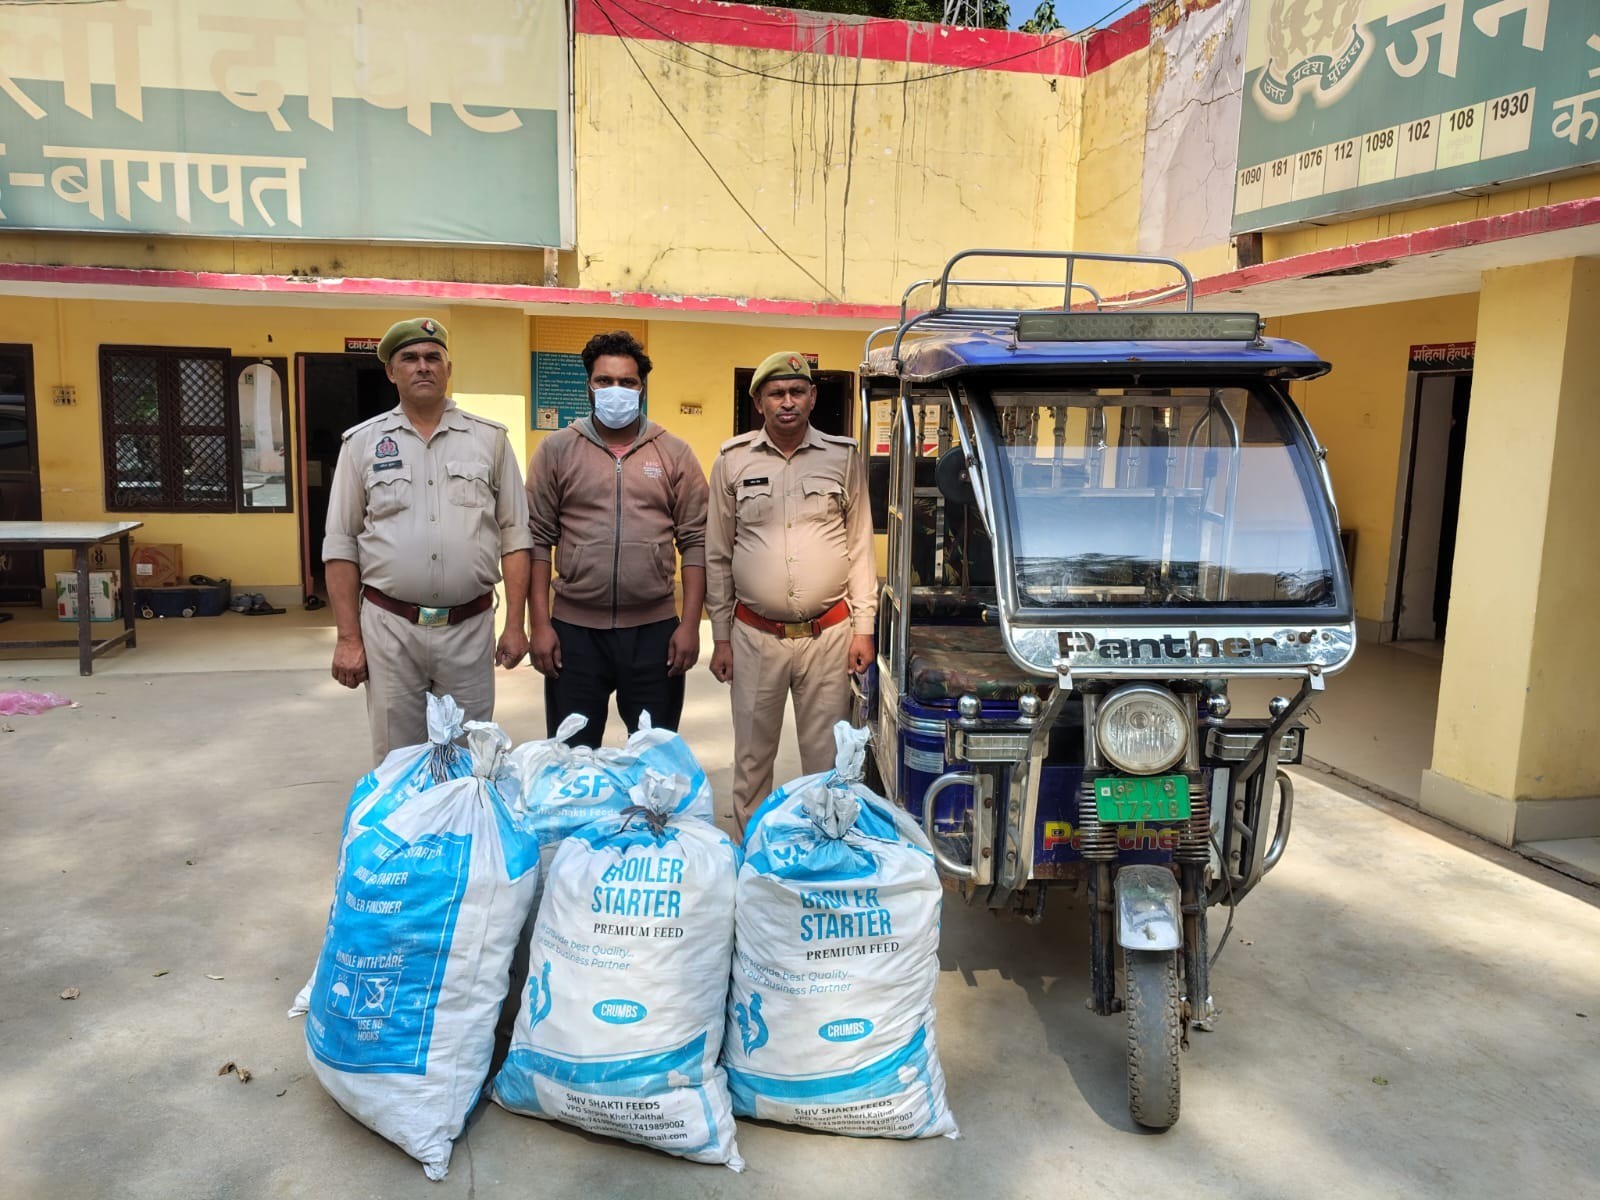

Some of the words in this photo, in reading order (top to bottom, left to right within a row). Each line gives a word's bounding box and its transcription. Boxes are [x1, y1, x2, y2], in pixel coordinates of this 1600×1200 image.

[1263, 79, 1286, 103] उत्तर
[1292, 59, 1325, 82] प्रदेश
[1327, 39, 1361, 87] पुलिस
[1240, 166, 1262, 187] 1090
[1271, 159, 1288, 178] 181
[1298, 149, 1323, 171] 1076
[1334, 140, 1353, 162] 112
[1365, 129, 1394, 153] 1098
[1407, 119, 1431, 142] 102
[1449, 108, 1474, 132] 108
[1492, 92, 1529, 121] 1930
[1413, 345, 1446, 366] महिला
[1057, 630, 1277, 659] Panther
[601, 856, 684, 884] BROILER
[591, 885, 681, 918] STARTER
[593, 922, 650, 937] PREMIUM
[654, 926, 684, 939] FEED
[800, 908, 893, 942] STARTER
[379, 952, 404, 968] CARE
[806, 945, 867, 961] PREMIUM
[869, 941, 900, 954] FEED
[591, 958, 631, 970] Partner
[809, 983, 853, 994] Partner
[601, 1003, 638, 1018] CRUMBS
[827, 1021, 865, 1037] CRUMBS
[566, 1093, 586, 1105] SHIV
[588, 1099, 623, 1110] SHAKTI
[625, 1101, 661, 1110] FEEDS
[794, 1108, 819, 1116] SHIV
[821, 1106, 858, 1114] SHAKTI
[860, 1099, 893, 1110] FEEDS
